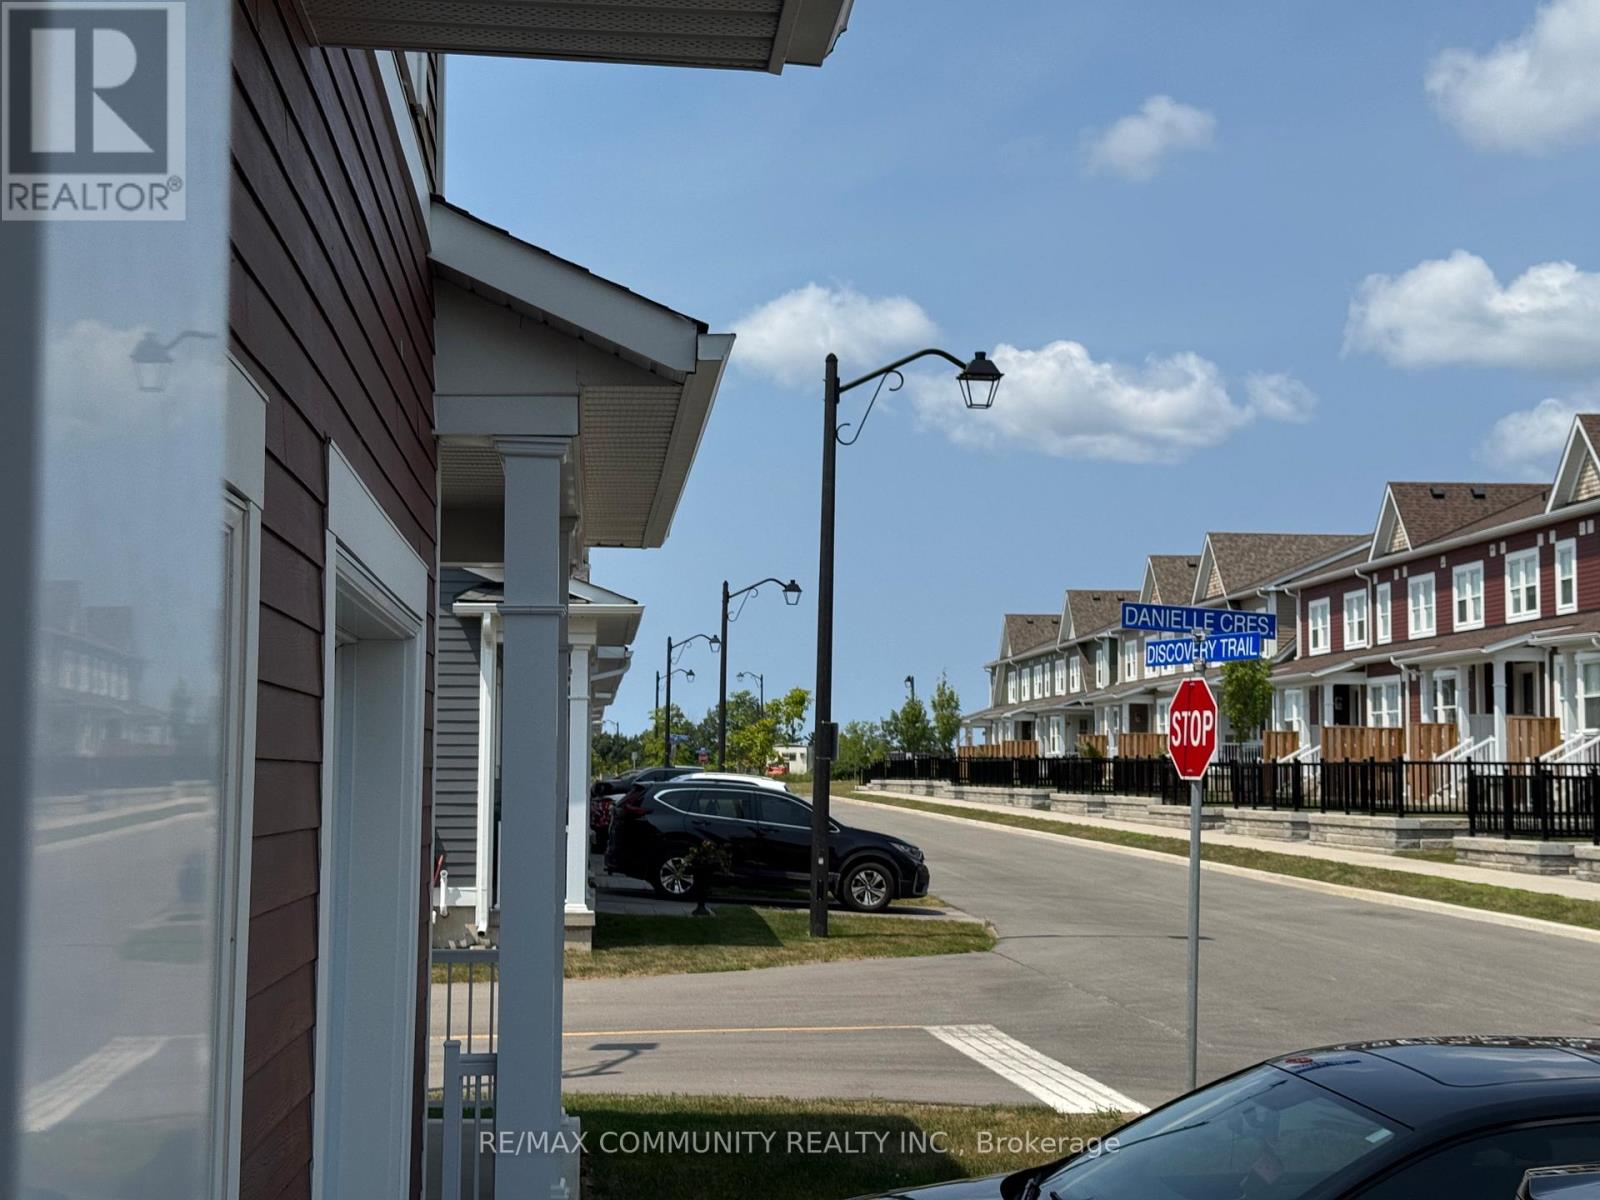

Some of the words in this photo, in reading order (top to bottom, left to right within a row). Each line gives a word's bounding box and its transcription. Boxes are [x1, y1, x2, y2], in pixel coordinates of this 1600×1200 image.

[1125, 606, 1214, 631] DANIELLE
[1147, 639, 1217, 664] DISCOVERY
[1220, 637, 1257, 658] TRAIL
[1171, 709, 1214, 747] STOP
